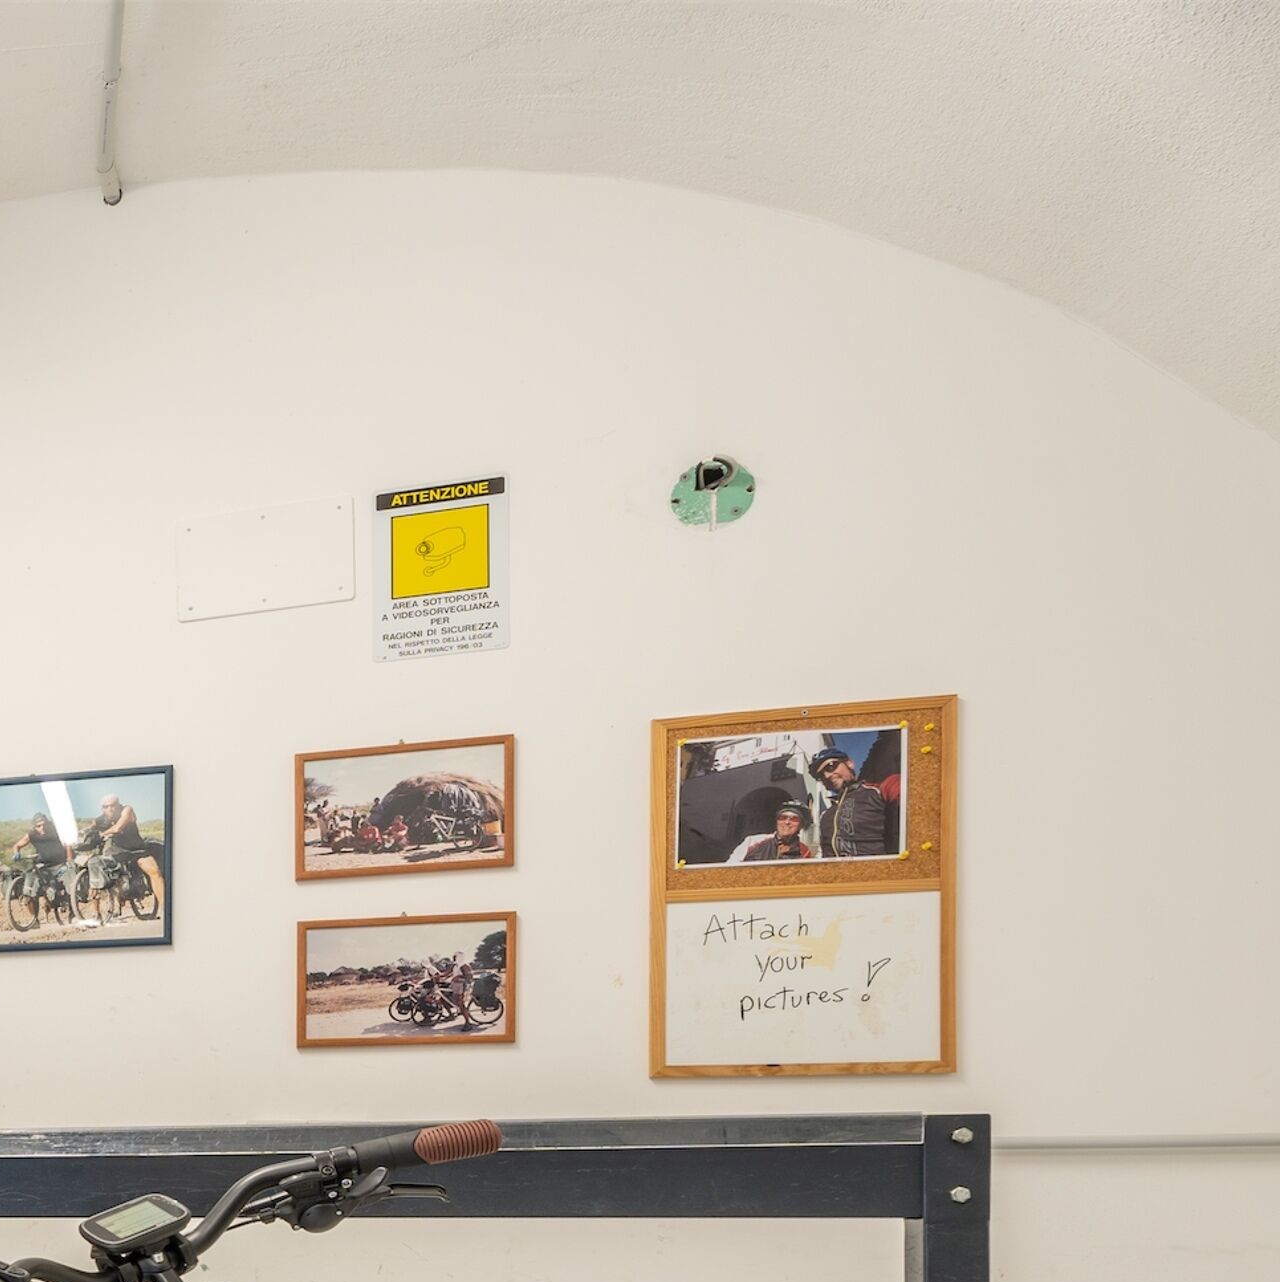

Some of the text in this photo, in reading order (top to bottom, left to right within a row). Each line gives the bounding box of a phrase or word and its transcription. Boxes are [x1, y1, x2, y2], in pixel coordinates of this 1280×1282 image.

[391, 481, 489, 507] ATTENZIONE
[392, 591, 489, 610] AREA SOTTOPOSTA
[382, 601, 500, 622] A VIDEOSORVEGLIANZA
[430, 617, 450, 626] PER
[382, 621, 499, 641] RAGIONI DI SICUREZZA
[404, 638, 440, 648] RISPETTO
[442, 635, 466, 644] DELLA
[468, 632, 494, 641] LEGGE
[398, 649, 422, 657] SULLA
[424, 645, 454, 654] PRIVACY
[702, 912, 810, 946] Attach
[754, 953, 813, 983] your
